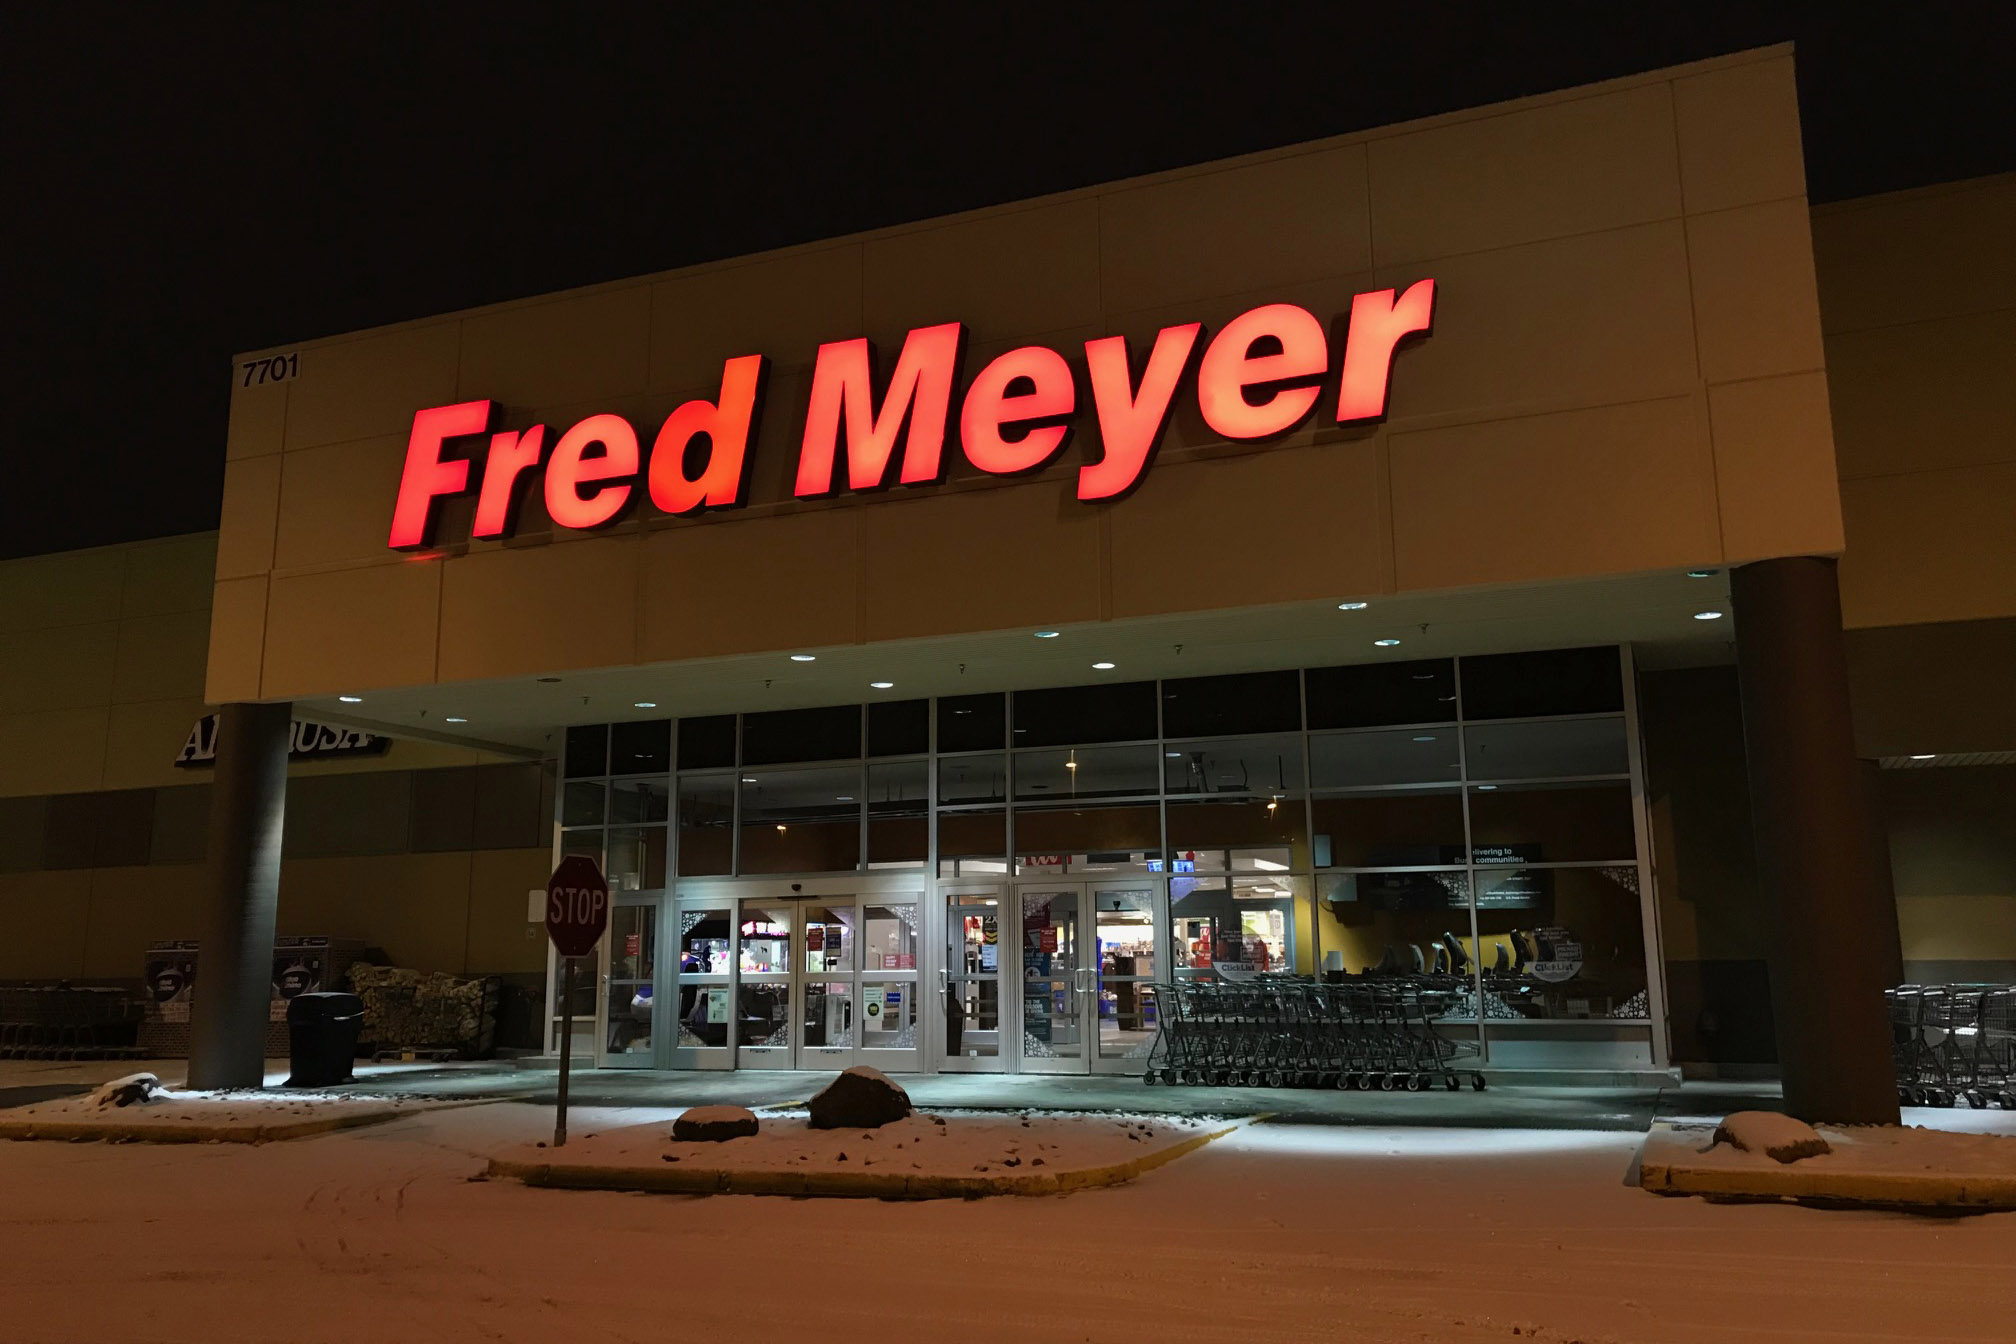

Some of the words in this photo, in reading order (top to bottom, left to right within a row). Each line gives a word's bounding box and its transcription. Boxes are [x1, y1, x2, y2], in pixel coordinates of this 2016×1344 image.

[243, 353, 297, 387] 7701
[388, 354, 766, 550] Fred
[794, 278, 1435, 503] Meyer
[1475, 855, 1524, 864] communities
[1504, 847, 1513, 855] to
[550, 886, 604, 925] STOP
